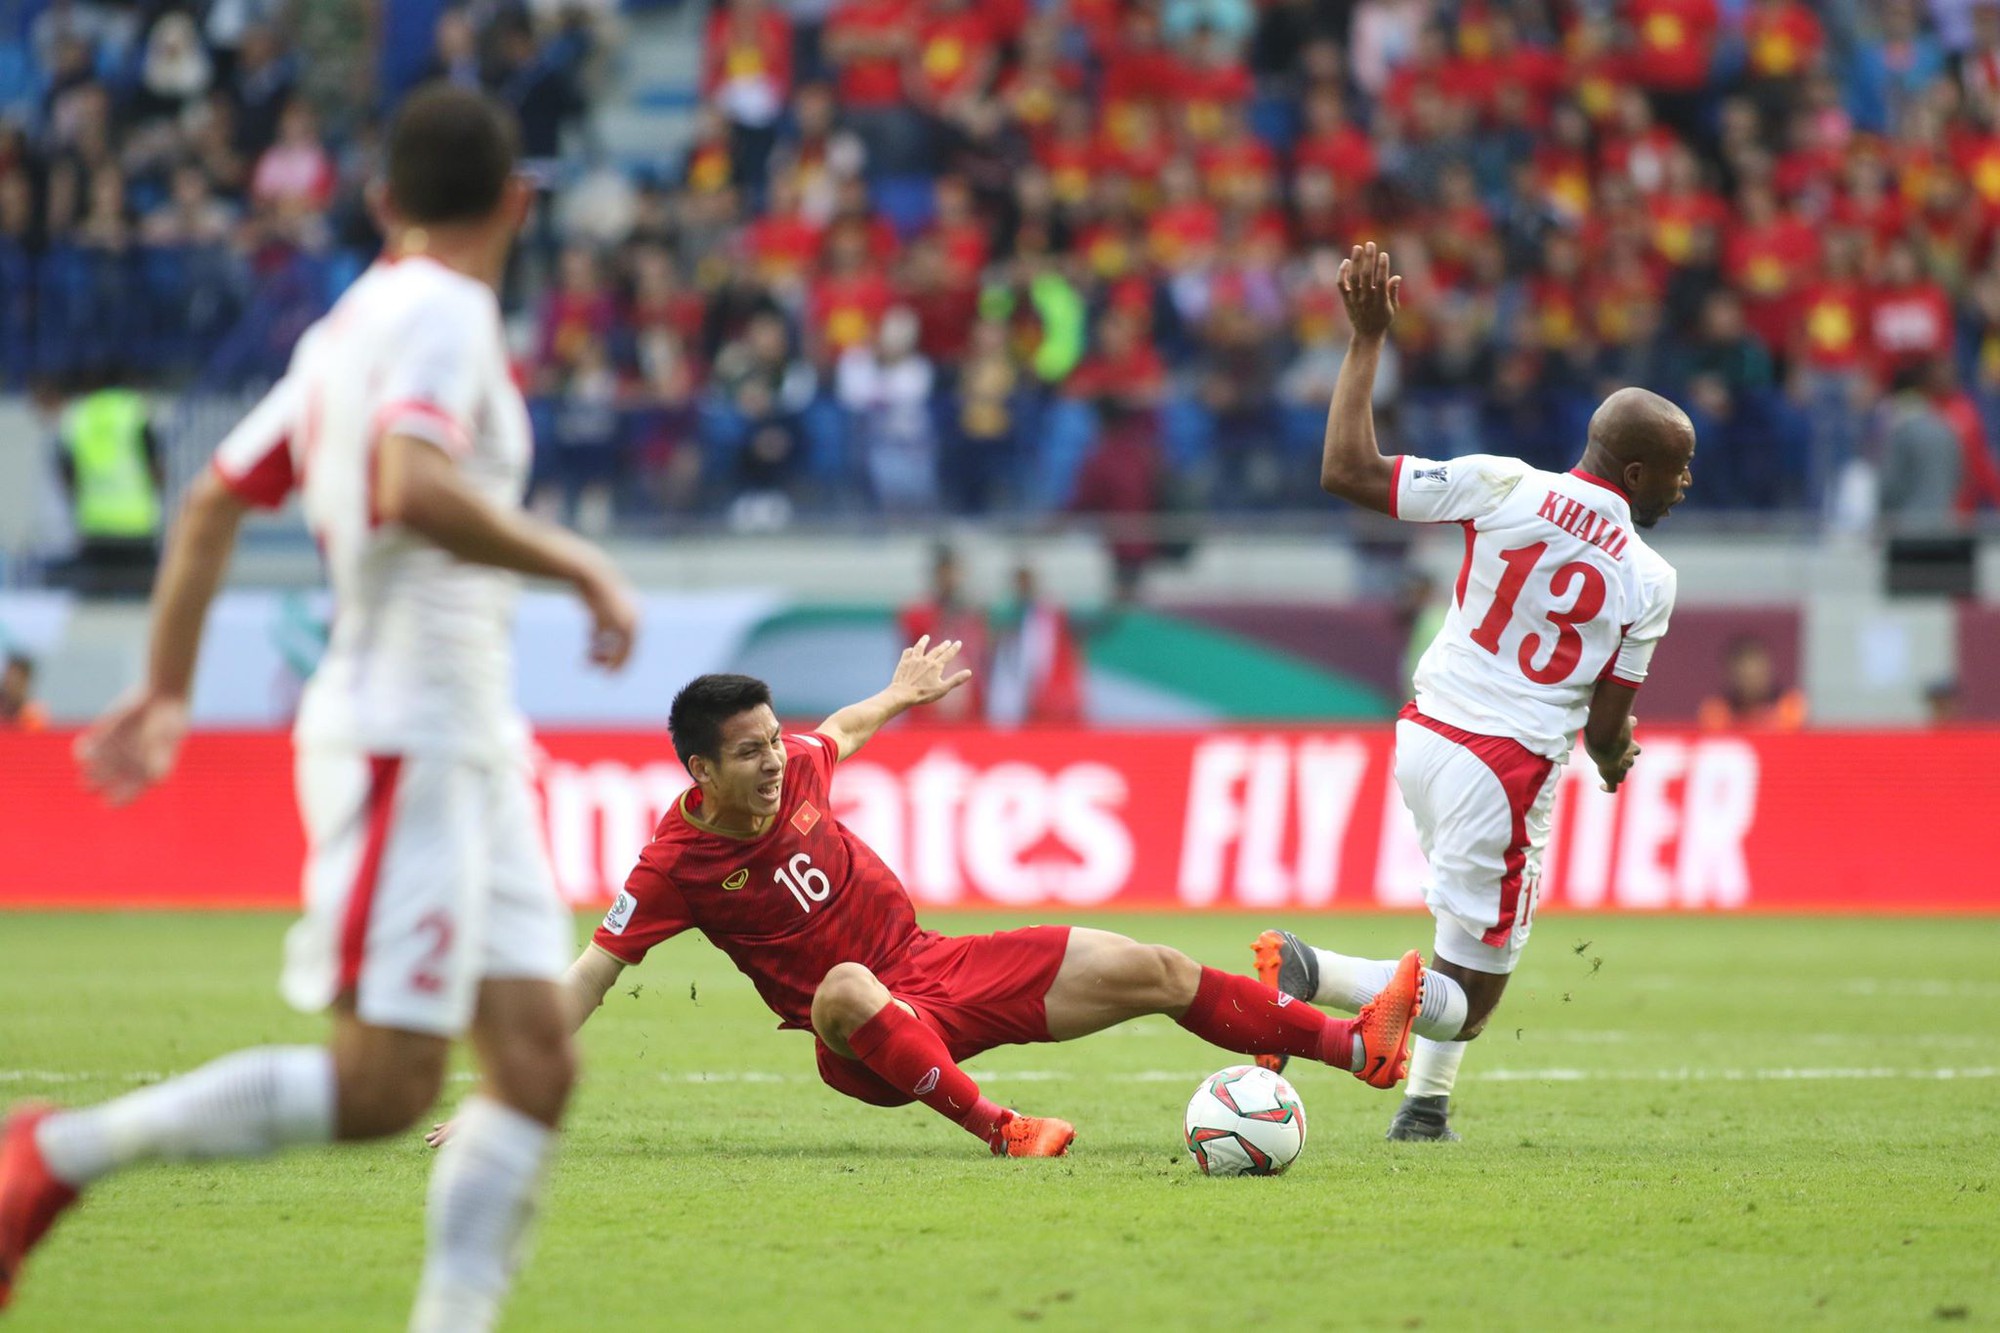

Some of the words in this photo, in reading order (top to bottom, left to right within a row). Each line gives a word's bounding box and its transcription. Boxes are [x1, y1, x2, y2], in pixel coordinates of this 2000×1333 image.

[1537, 490, 1630, 562] KHALIL
[1469, 541, 1606, 685] 13
[1177, 738, 1368, 908] FLY
[773, 852, 831, 914] 16
[409, 906, 455, 995] 2
